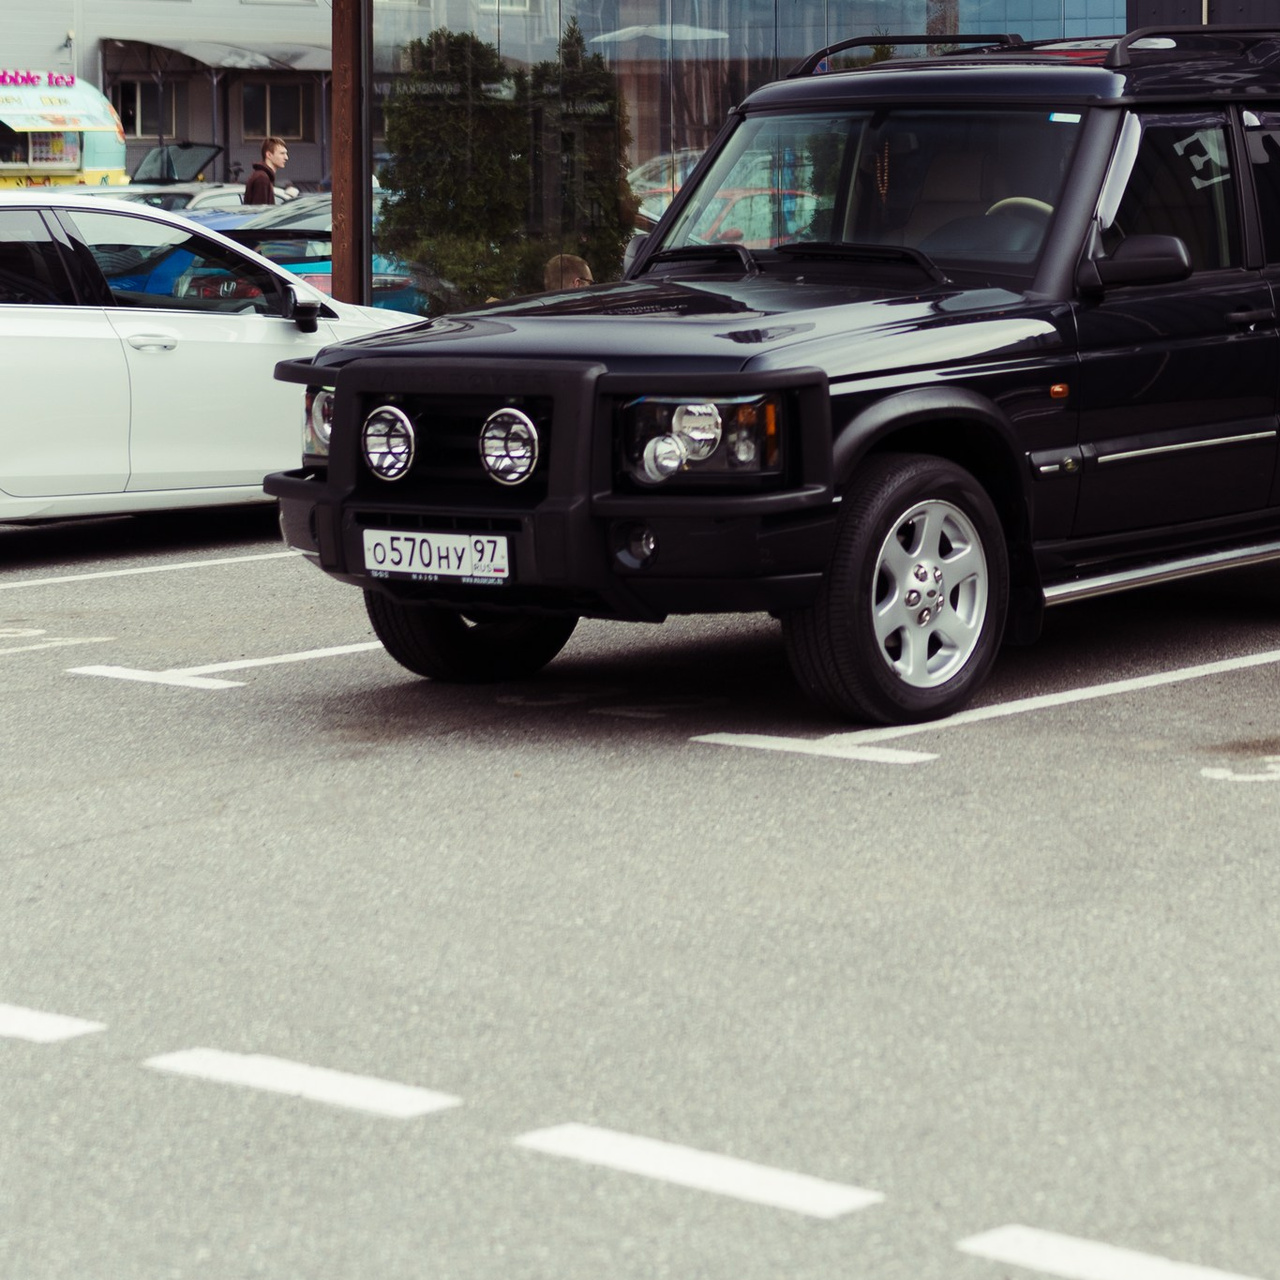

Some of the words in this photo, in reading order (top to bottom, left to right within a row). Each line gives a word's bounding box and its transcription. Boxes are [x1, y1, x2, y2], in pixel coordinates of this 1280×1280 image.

[47, 71, 75, 87] tea
[473, 539, 498, 563] 97
[473, 563, 493, 572] RUS
